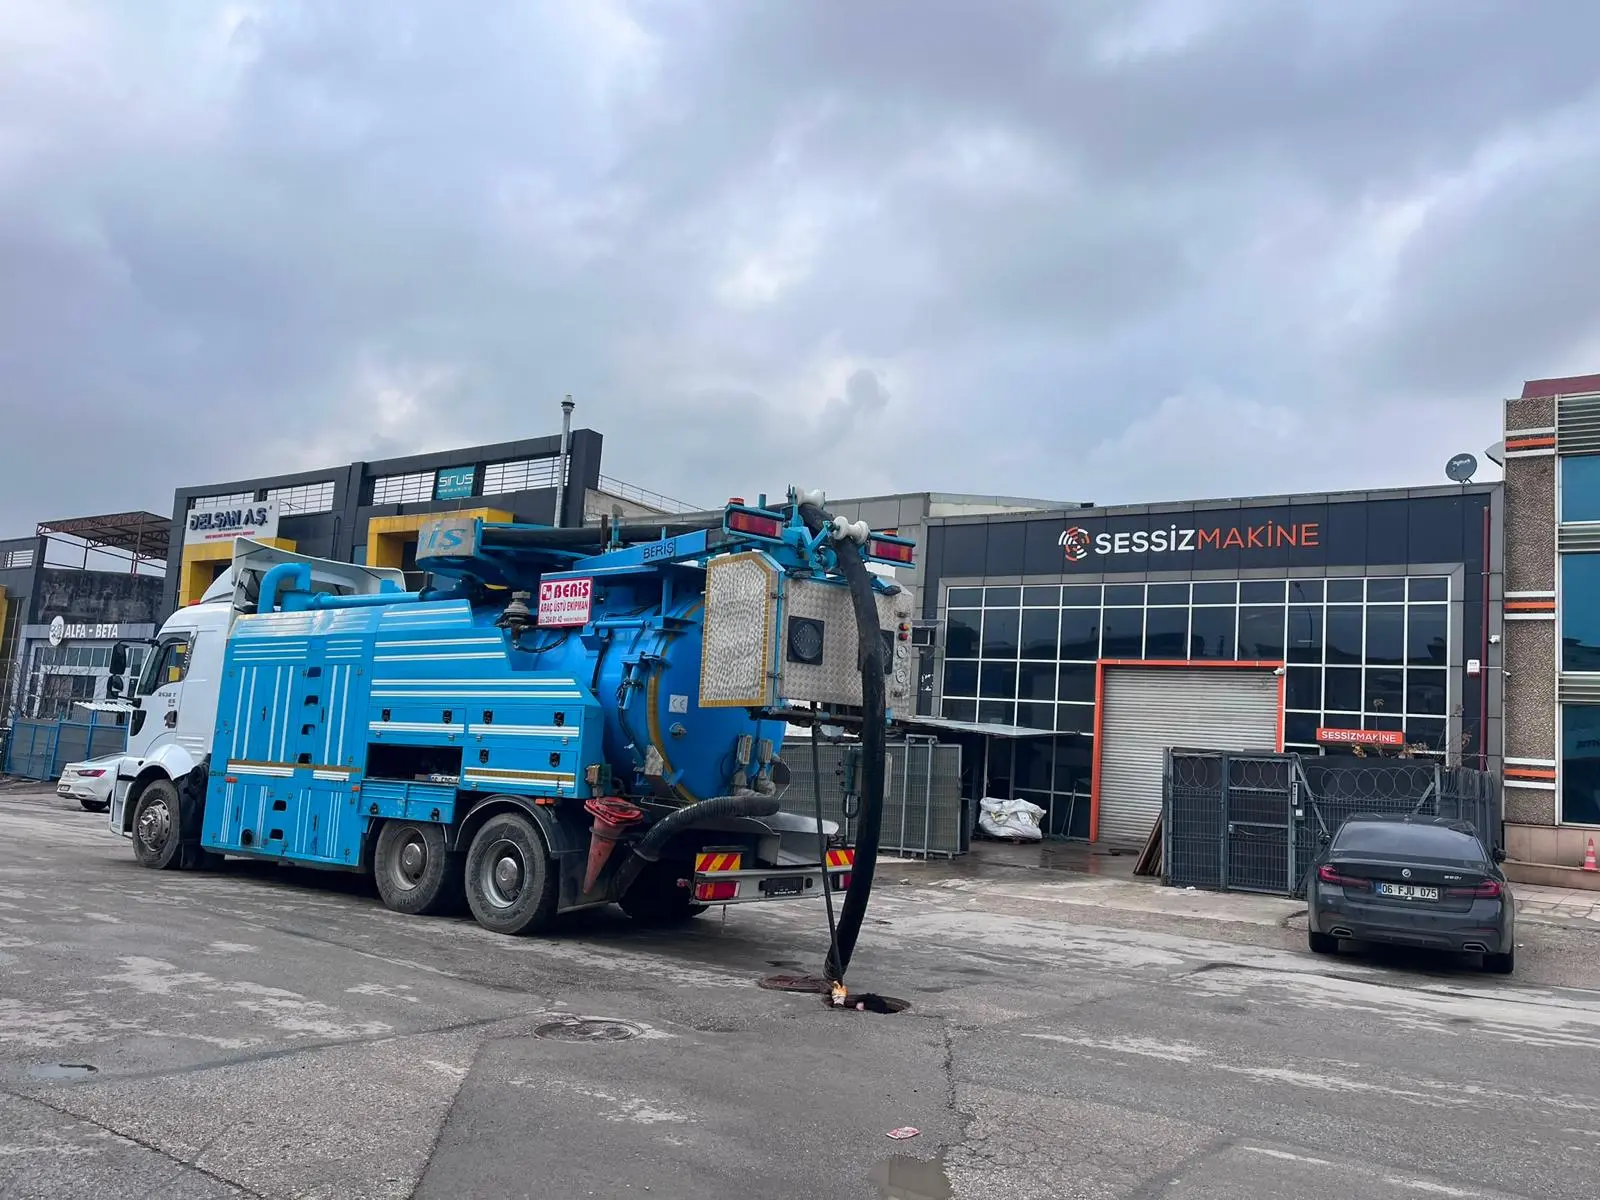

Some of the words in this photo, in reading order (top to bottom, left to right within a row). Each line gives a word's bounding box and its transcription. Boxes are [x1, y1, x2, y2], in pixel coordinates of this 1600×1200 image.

[190, 510, 242, 531] DELSAN
[1094, 520, 1319, 555] SESSİZMAKİNE
[541, 602, 553, 613] ARAÇ
[64, 624, 86, 638] ALFA
[95, 624, 118, 638] BETA
[1321, 731, 1397, 742] SESSİZMAKİNE
[1382, 885, 1393, 894] 06
[1398, 886, 1415, 896] FJU
[1420, 888, 1437, 898] 075
